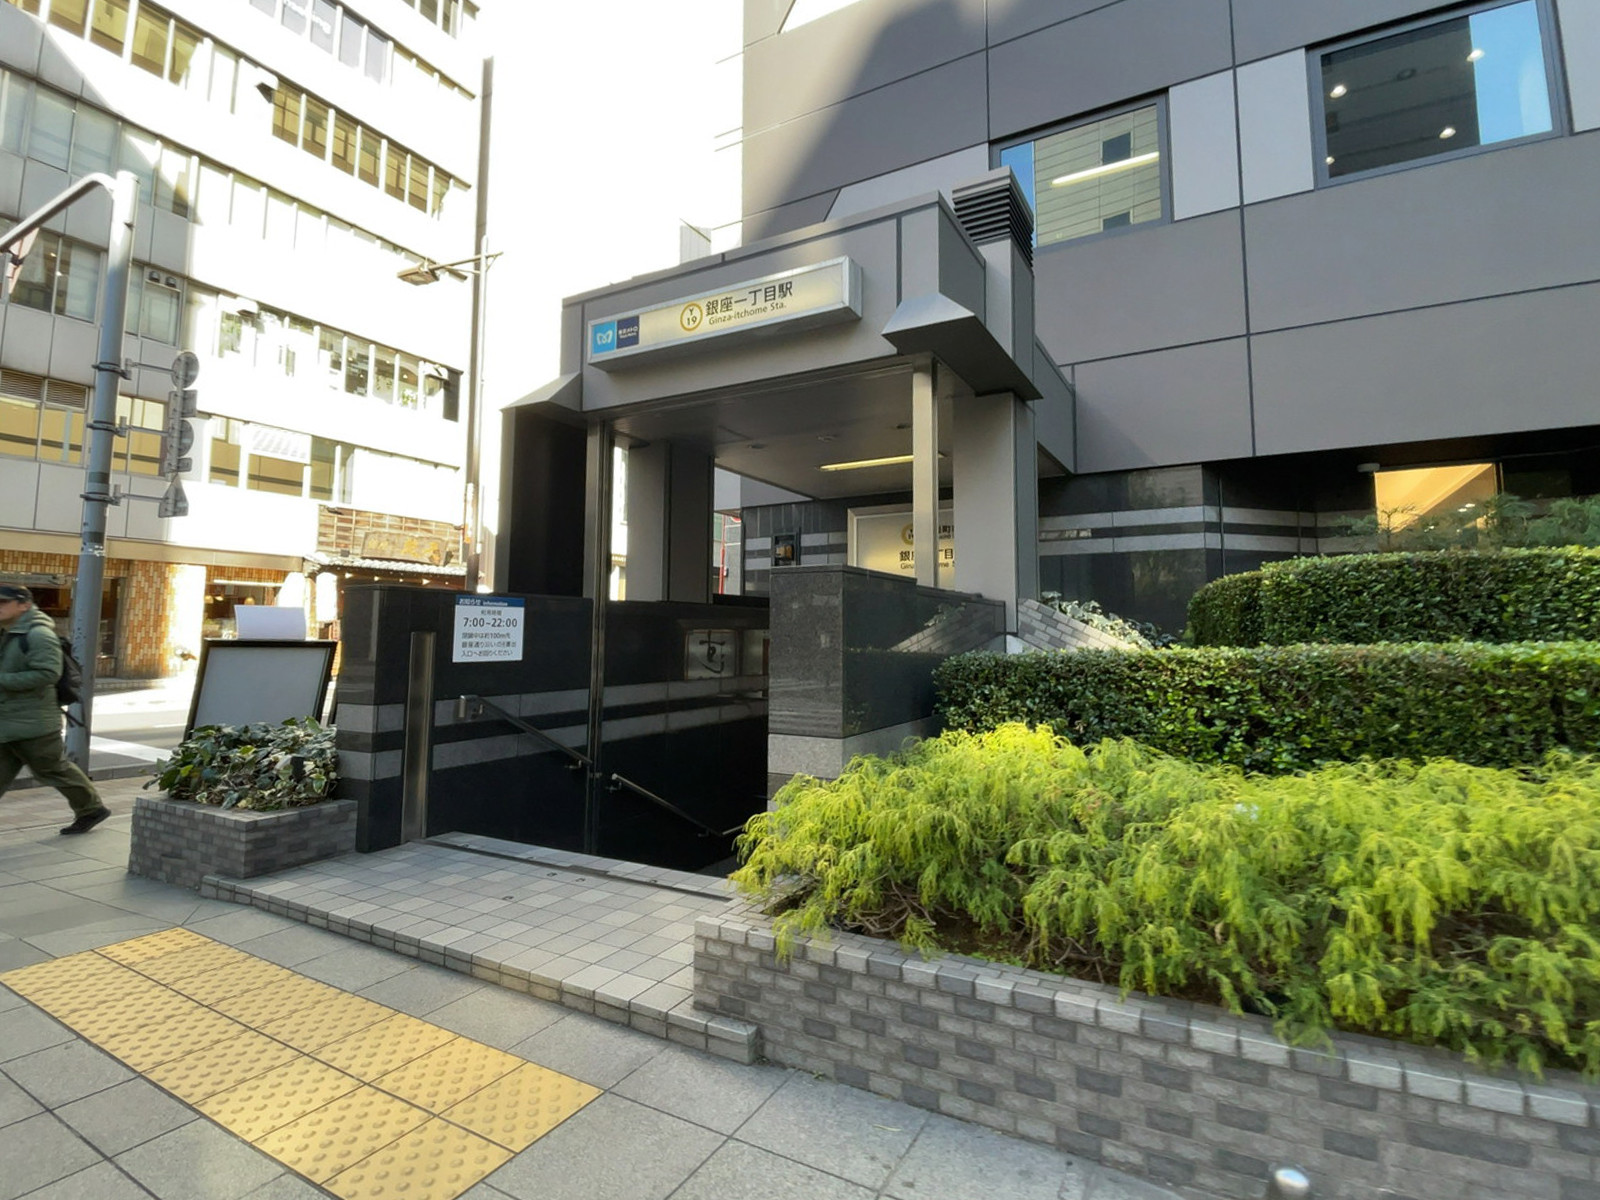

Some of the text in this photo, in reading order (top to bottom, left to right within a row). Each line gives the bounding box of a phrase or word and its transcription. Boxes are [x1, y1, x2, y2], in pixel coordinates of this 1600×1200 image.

[705, 281, 793, 316] 銀座一丁目駅
[688, 307, 694, 316] Y
[708, 300, 787, 325] Ginza-itchome Sta.
[687, 316, 697, 325] 19
